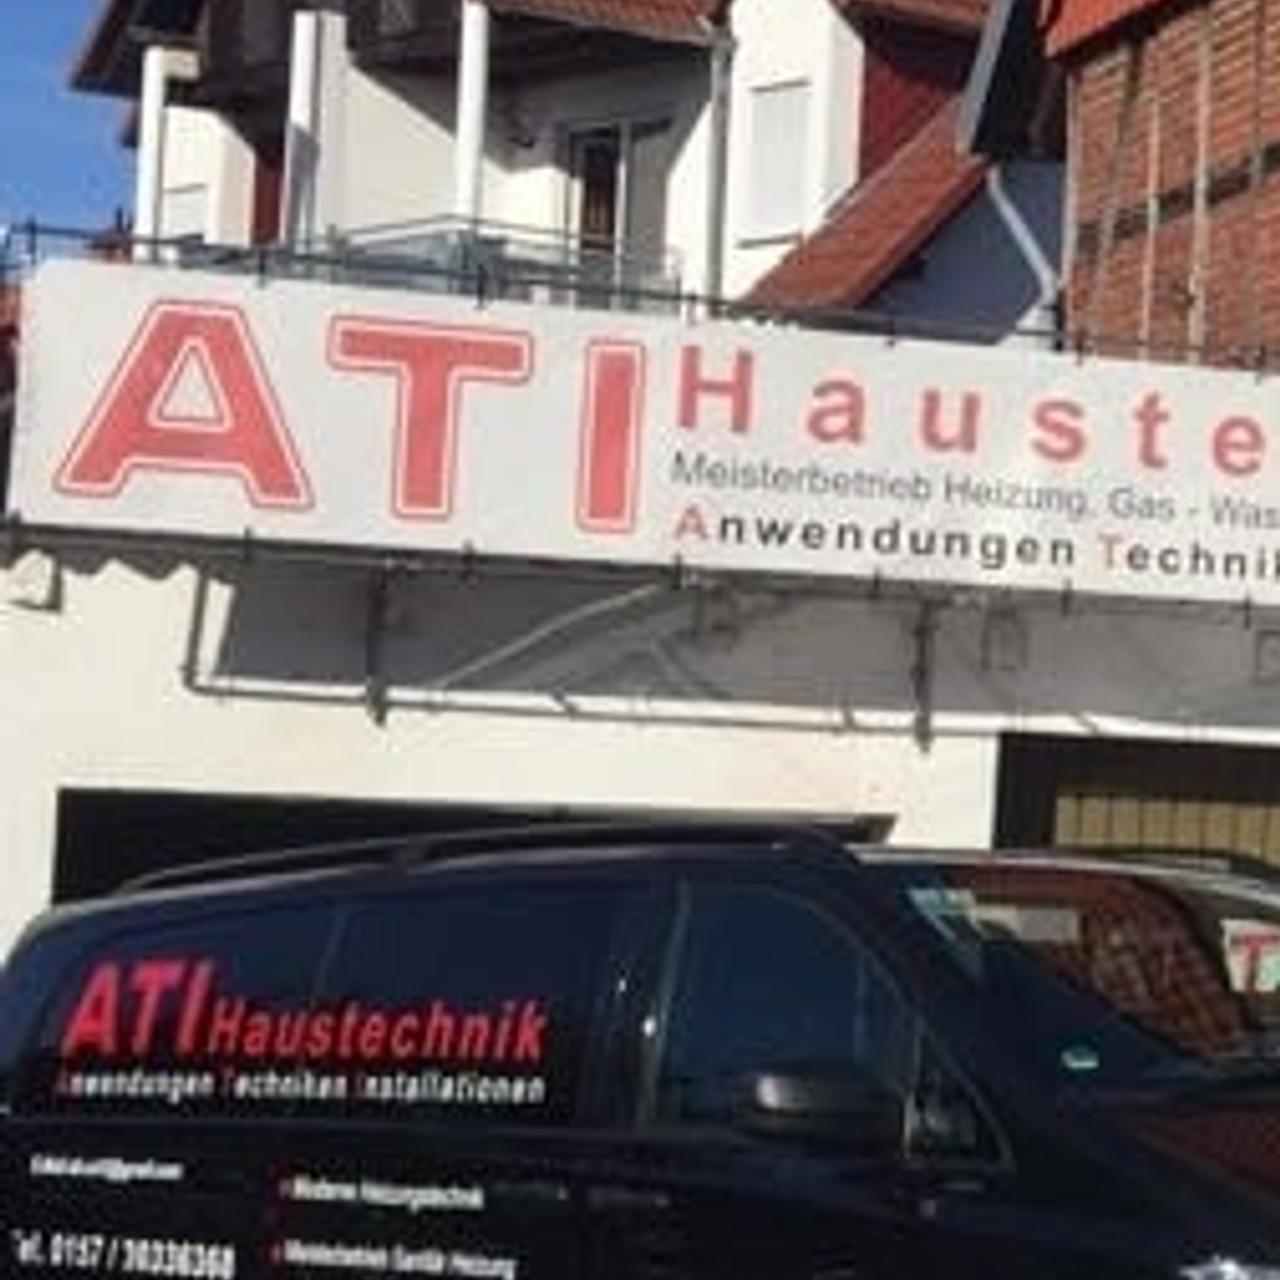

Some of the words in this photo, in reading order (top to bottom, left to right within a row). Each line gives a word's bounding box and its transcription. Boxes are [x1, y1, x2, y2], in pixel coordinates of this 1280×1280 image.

[52, 299, 647, 534] ATI
[669, 450, 931, 503] Meisterbetrieb
[1107, 485, 1176, 520] Gas
[674, 504, 1075, 570] Anwendungen
[60, 958, 219, 1058] ATI
[207, 996, 549, 1062] Haustechnik
